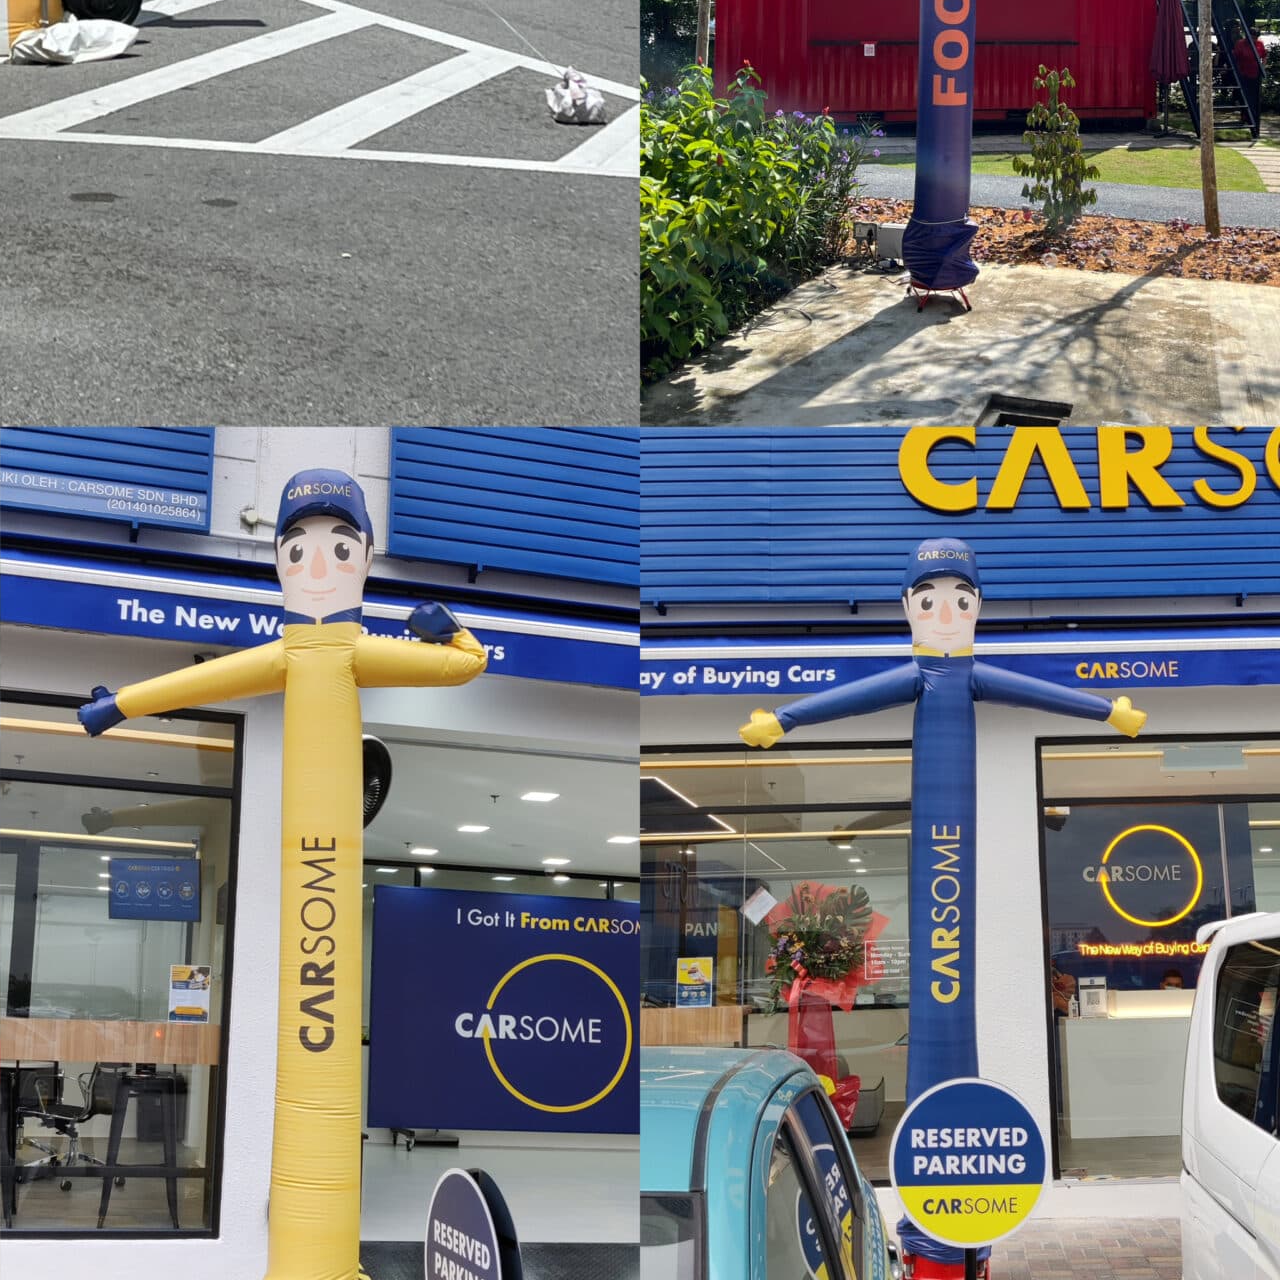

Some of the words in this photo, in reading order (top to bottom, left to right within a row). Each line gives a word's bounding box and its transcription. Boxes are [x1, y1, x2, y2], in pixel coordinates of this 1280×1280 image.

[898, 427, 1280, 511] CARS
[0, 472, 18, 485] IKI
[22, 474, 58, 489] OLEH
[68, 480, 133, 499] CARSOME
[137, 489, 168, 503] SDN.
[171, 493, 201, 506] BHD.
[287, 483, 352, 500] CARSOME
[106, 498, 201, 521] (201401025864)
[917, 549, 969, 562] CARSOME
[117, 598, 166, 625] The
[175, 605, 240, 632] New
[673, 665, 697, 684] of
[703, 665, 780, 689] Buying
[787, 665, 836, 683] Cars
[1075, 660, 1179, 680] CARSOME
[1082, 864, 1182, 883] CARSOME
[457, 908, 461, 925] I
[467, 908, 500, 927] Got
[505, 911, 516, 928] It
[520, 912, 570, 932] From
[931, 823, 961, 1004] CARSOME
[299, 836, 336, 1054] CARSOME
[1080, 944, 1099, 956] The
[1099, 944, 1120, 956] New
[1120, 943, 1142, 957] Way
[1143, 941, 1155, 955] of
[1155, 942, 1189, 956] Buying
[455, 1012, 602, 1044] CARSOME
[911, 1127, 1028, 1148] RESERVED
[913, 1153, 1027, 1175] PARKING
[922, 1197, 1018, 1215] CARSOME
[433, 1219, 491, 1270] RESERVED
